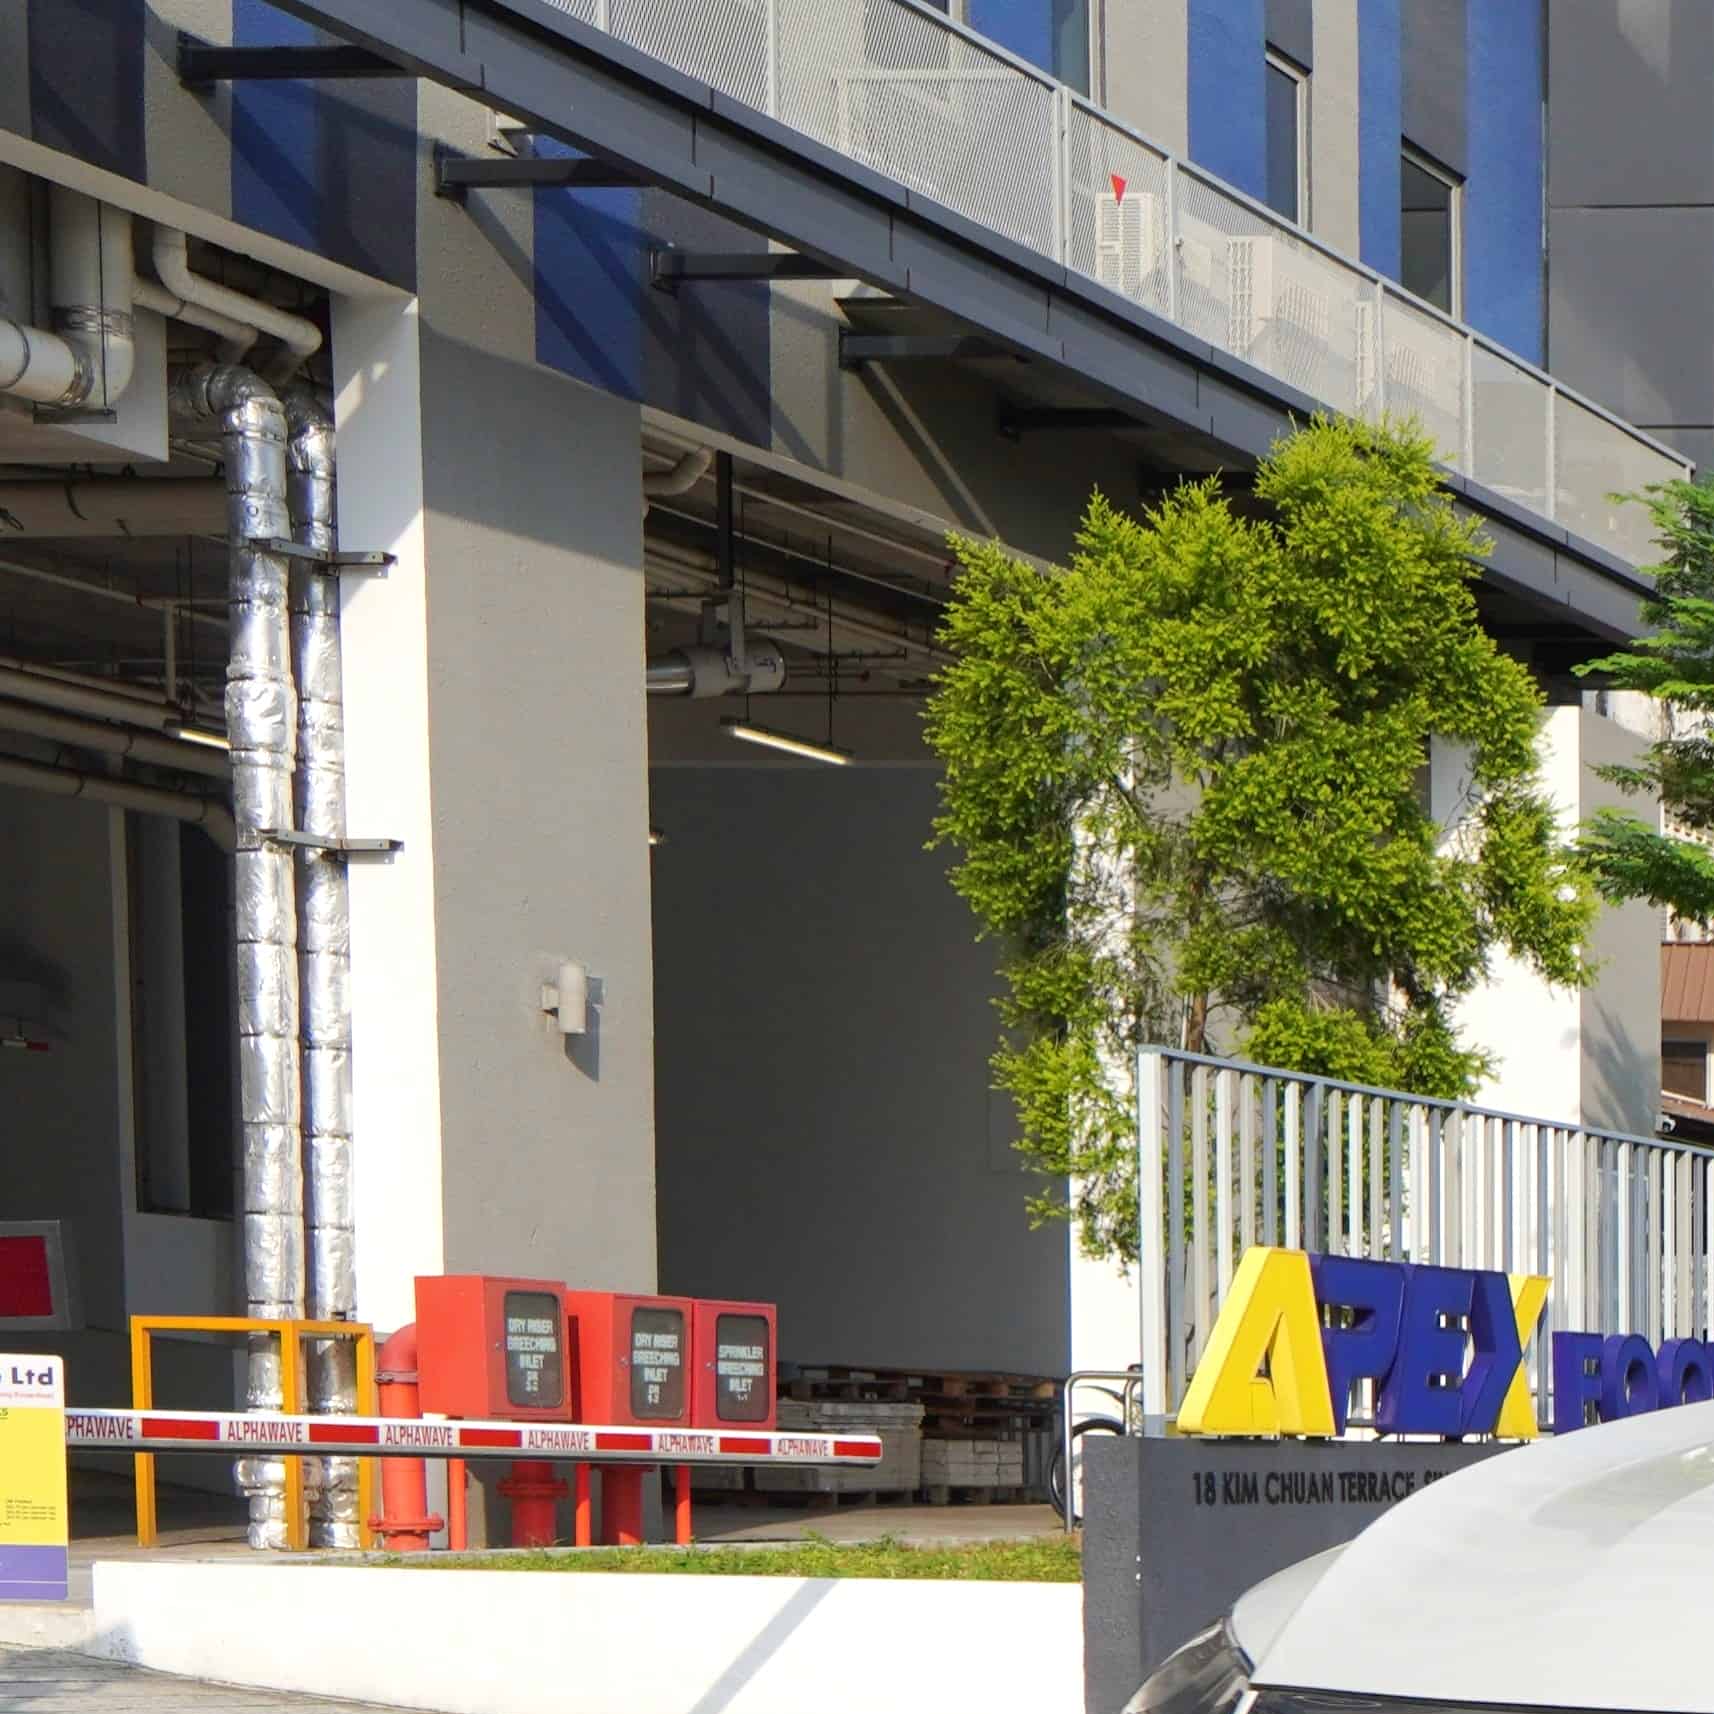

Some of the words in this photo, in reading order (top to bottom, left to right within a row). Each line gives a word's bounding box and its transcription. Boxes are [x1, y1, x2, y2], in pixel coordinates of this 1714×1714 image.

[1177, 1246, 1552, 1438] APEX
[11, 1367, 54, 1385] Ltd
[67, 1416, 133, 1439] PHAWAVE
[227, 1420, 303, 1443] ALPHAWAVE
[385, 1423, 453, 1446] ALPHAWAVE
[528, 1430, 590, 1451] ALPHAWAVE
[658, 1434, 714, 1454] ALPHAWAVE
[777, 1438, 829, 1457] ALPHAWAVE
[1193, 1471, 1216, 1506] 18
[1221, 1471, 1260, 1505] KIM
[1264, 1471, 1334, 1505] CHUAN
